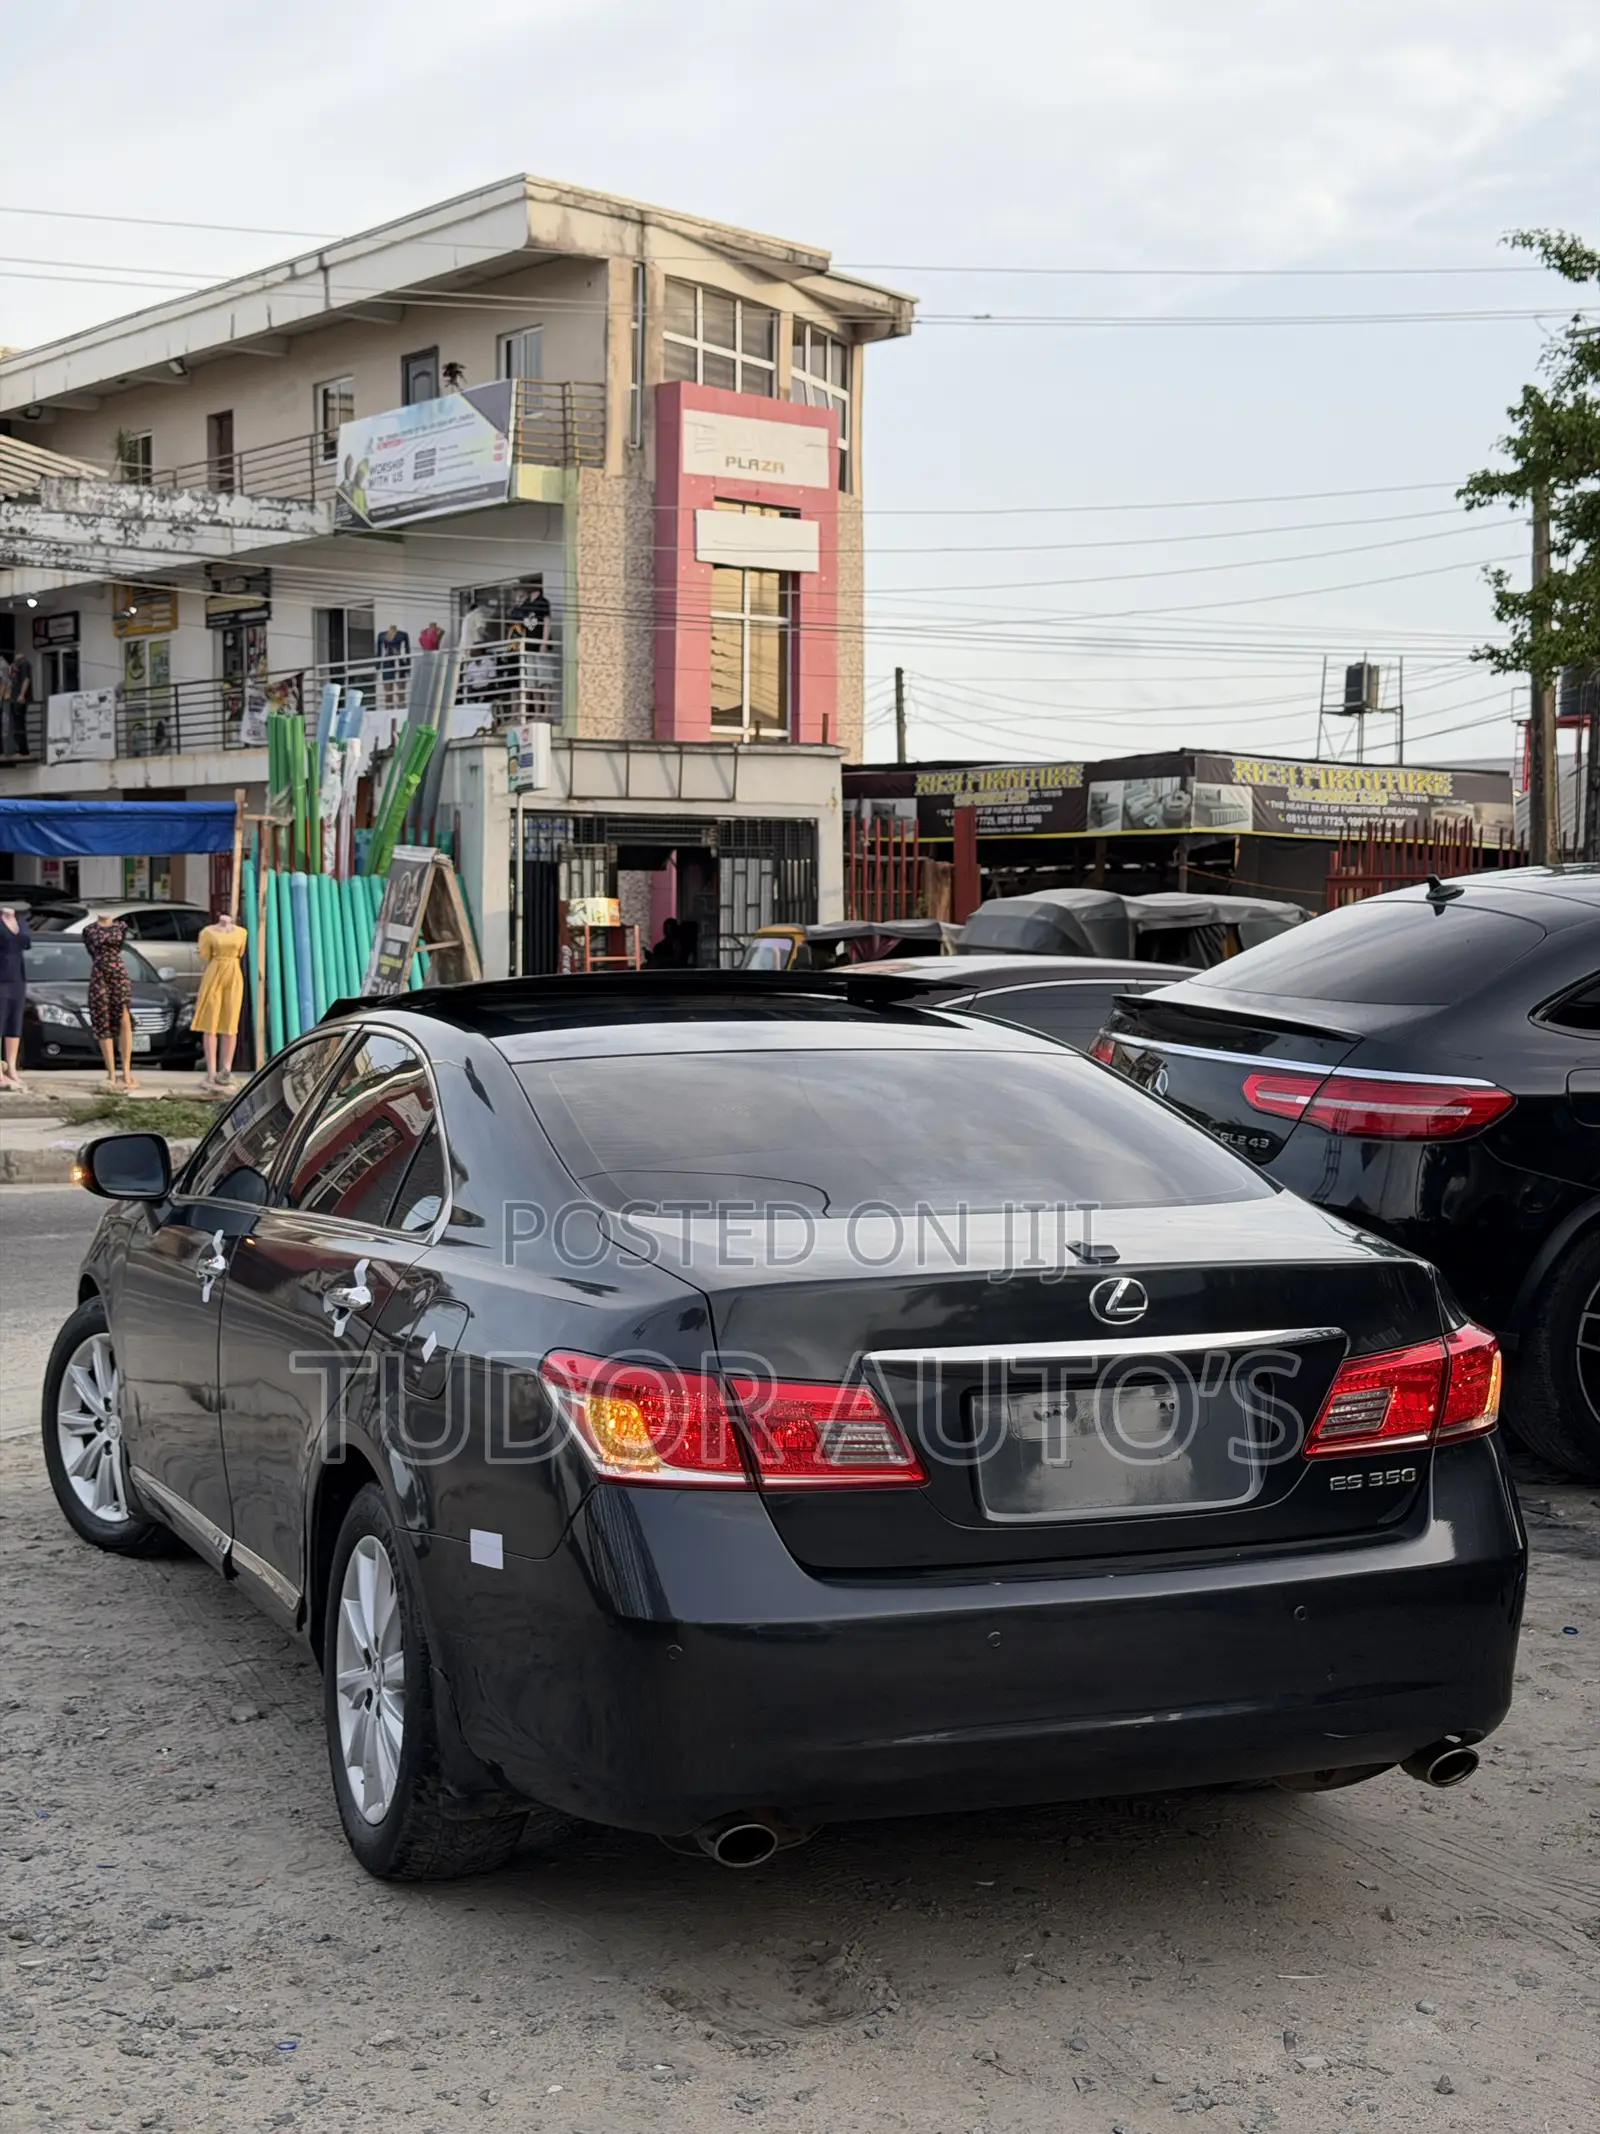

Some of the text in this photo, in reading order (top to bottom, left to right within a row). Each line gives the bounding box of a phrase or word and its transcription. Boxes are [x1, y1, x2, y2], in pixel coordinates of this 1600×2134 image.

[369, 458, 405, 476] WORSHIP
[725, 456, 785, 474] PLAZA
[368, 470, 404, 488] WITH US
[967, 764, 1084, 793] FURNITURE
[1303, 766, 1453, 796] FURNITURE
[1286, 802, 1310, 813] HEART
[1329, 804, 1340, 814] OF
[1341, 805, 1381, 815] FURNITURE
[1382, 806, 1418, 816] CREATION
[1220, 1132, 1270, 1149] GLE 43
[1330, 1468, 1416, 1491] ES 350
